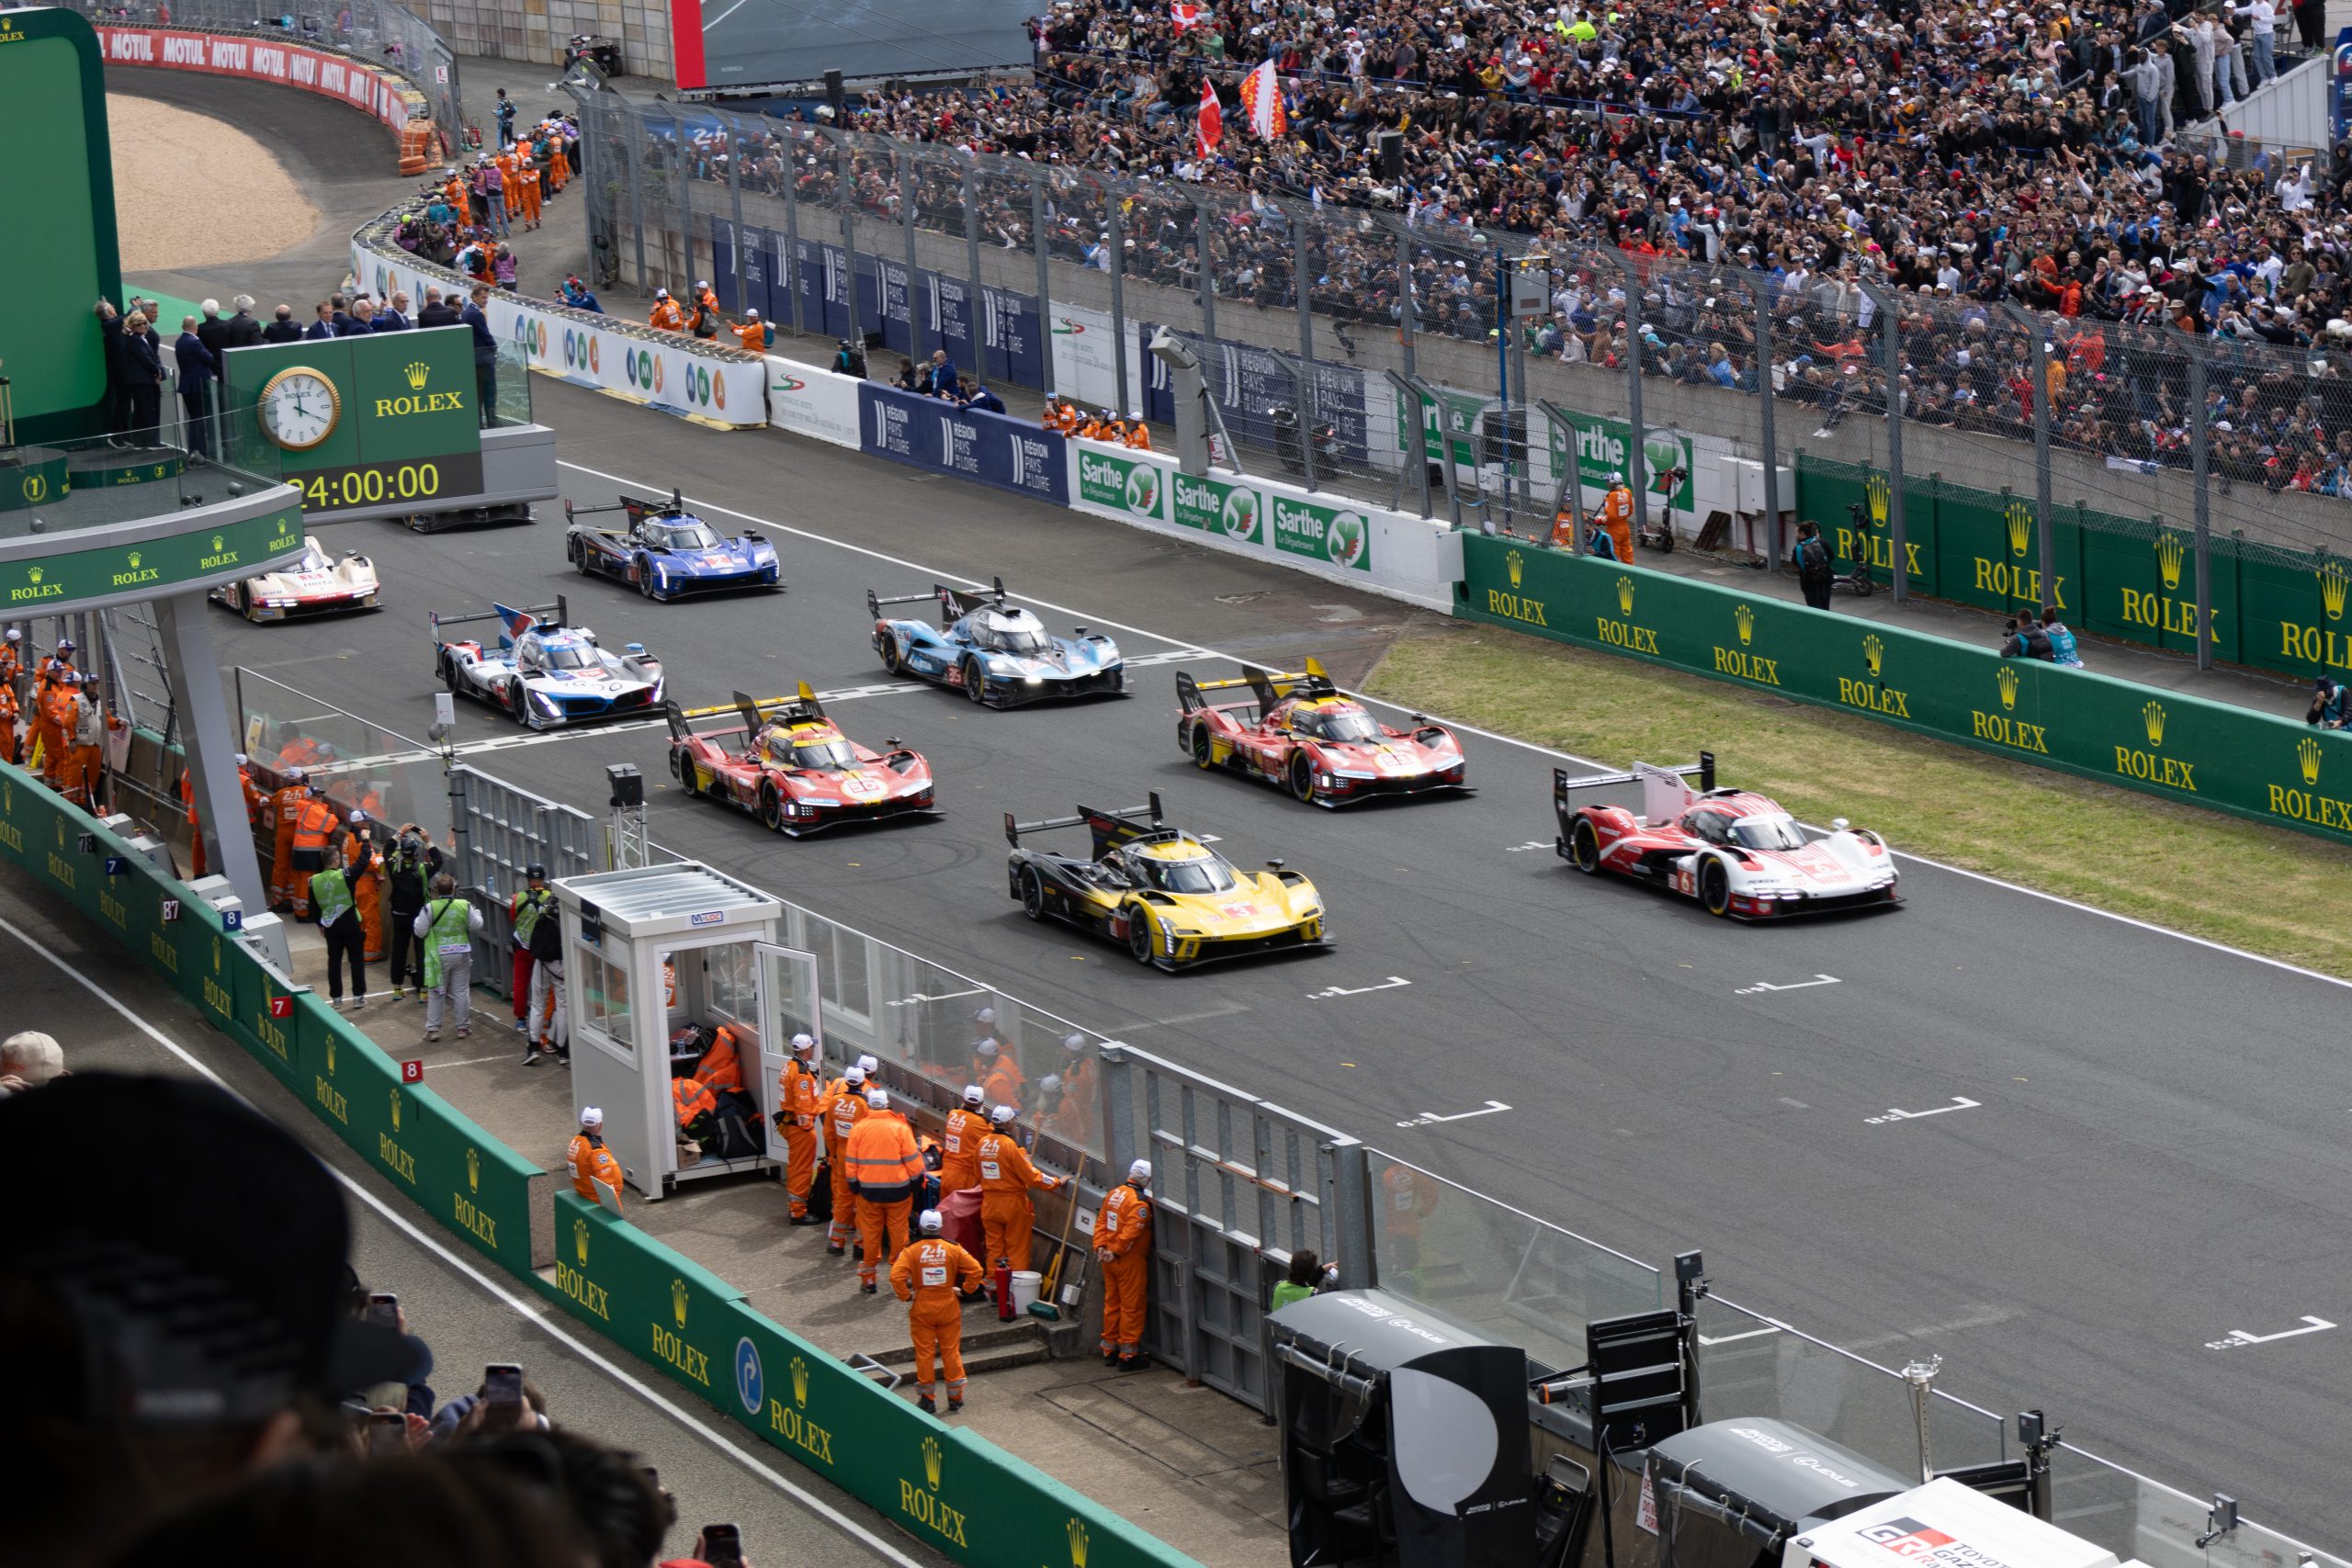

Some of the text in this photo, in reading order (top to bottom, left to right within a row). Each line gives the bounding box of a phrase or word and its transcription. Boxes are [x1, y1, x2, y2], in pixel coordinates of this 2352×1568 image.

[111, 33, 153, 61] MOTUL
[164, 37, 205, 65] MOTUL
[253, 47, 285, 77] MOTUL
[942, 299, 958, 320] PAYS
[1241, 352, 1275, 376] RÉGION
[285, 390, 312, 399] ROLEX
[1242, 376, 1265, 394] PAYS
[375, 391, 464, 418] ROLEX
[887, 405, 909, 423] RÉGION
[888, 420, 902, 437] PAYS
[954, 422, 977, 441] RÉGION
[893, 437, 910, 456] LOIRE
[954, 438, 970, 456] PAYS
[1024, 439, 1048, 458] RÉGION
[962, 456, 978, 474] LOIRE
[1024, 456, 1042, 474] PAYS
[1081, 455, 1123, 490] Sarthe
[31, 478, 39, 496] 1
[287, 463, 440, 509] 24:00:00
[1031, 474, 1050, 492] LOIRE
[1176, 478, 1220, 513] Sarthe
[1276, 502, 1324, 539] Sarthe
[268, 534, 297, 552] ROLEX
[200, 551, 239, 570] ROLEX
[113, 568, 160, 586] ROLEX
[11, 583, 63, 601] ROLEX
[1488, 589, 1547, 626] ROLEX
[1597, 616, 1660, 655] ROLEX
[1713, 646, 1781, 685] ROLEX
[948, 669, 964, 684] 35
[1838, 677, 1911, 718] ROLEX
[1972, 710, 2050, 754] ROLEX
[2115, 746, 2198, 792] ROLEX
[2267, 784, 2352, 831] ROLEX
[80, 835, 93, 853] 78
[48, 852, 75, 889] ROLEX
[107, 860, 117, 873] 7
[1680, 874, 1692, 893] 6
[163, 900, 179, 919] 87
[227, 911, 236, 925] 8
[691, 912, 721, 923] M-LOC
[1234, 905, 1251, 919] 3
[151, 931, 178, 974] ROLEX
[204, 976, 232, 1021] ROLEX
[274, 1000, 284, 1014] 7
[407, 1063, 417, 1077] 8
[316, 1074, 348, 1126] ROLEX
[379, 1131, 416, 1185] ROLEX
[454, 1191, 498, 1249] ROLEX
[556, 1259, 610, 1322] ROLEX
[1404, 1322, 1447, 1344] LEXUS
[651, 1322, 710, 1387] ROLEX
[769, 1397, 834, 1465] ROLEX
[1810, 1464, 1860, 1488] LEXUS
[1505, 1498, 1528, 1506] LEXUS
[899, 1477, 968, 1549] ROLEX
